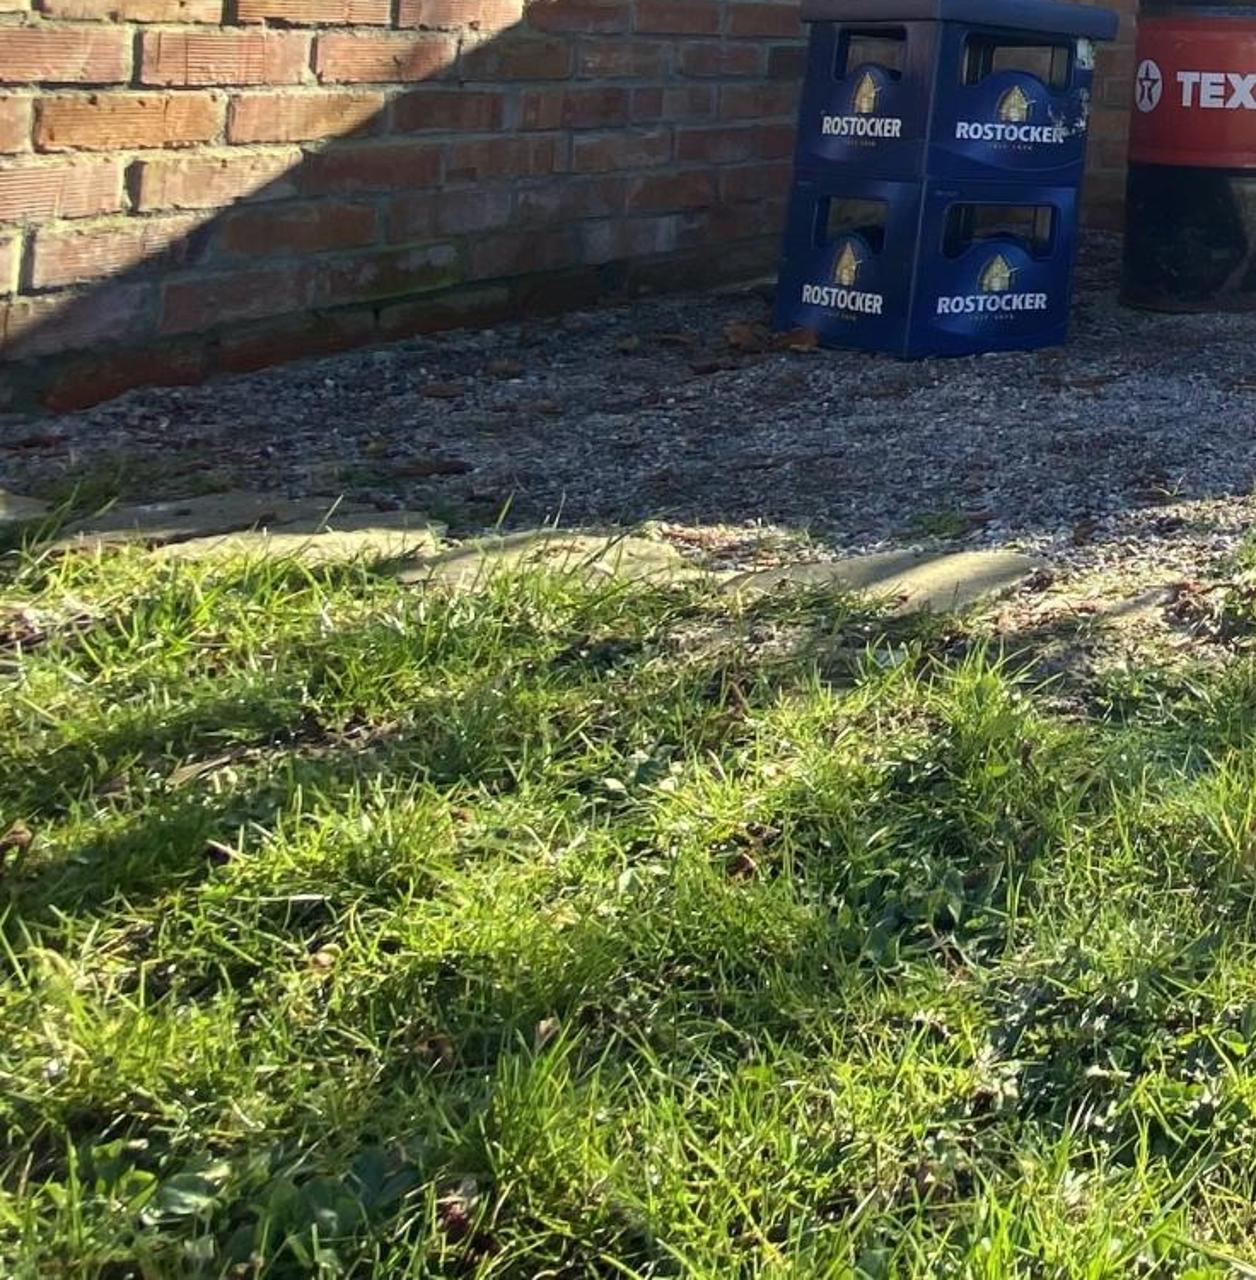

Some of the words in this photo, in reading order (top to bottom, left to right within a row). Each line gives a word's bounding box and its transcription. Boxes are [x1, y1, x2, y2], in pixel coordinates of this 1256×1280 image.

[822, 116, 902, 138] ROSTOCKER
[956, 122, 1064, 144] ROSTOCKER
[802, 284, 883, 315] ROSTOCKER
[937, 293, 1048, 314] ROSTOCKER
